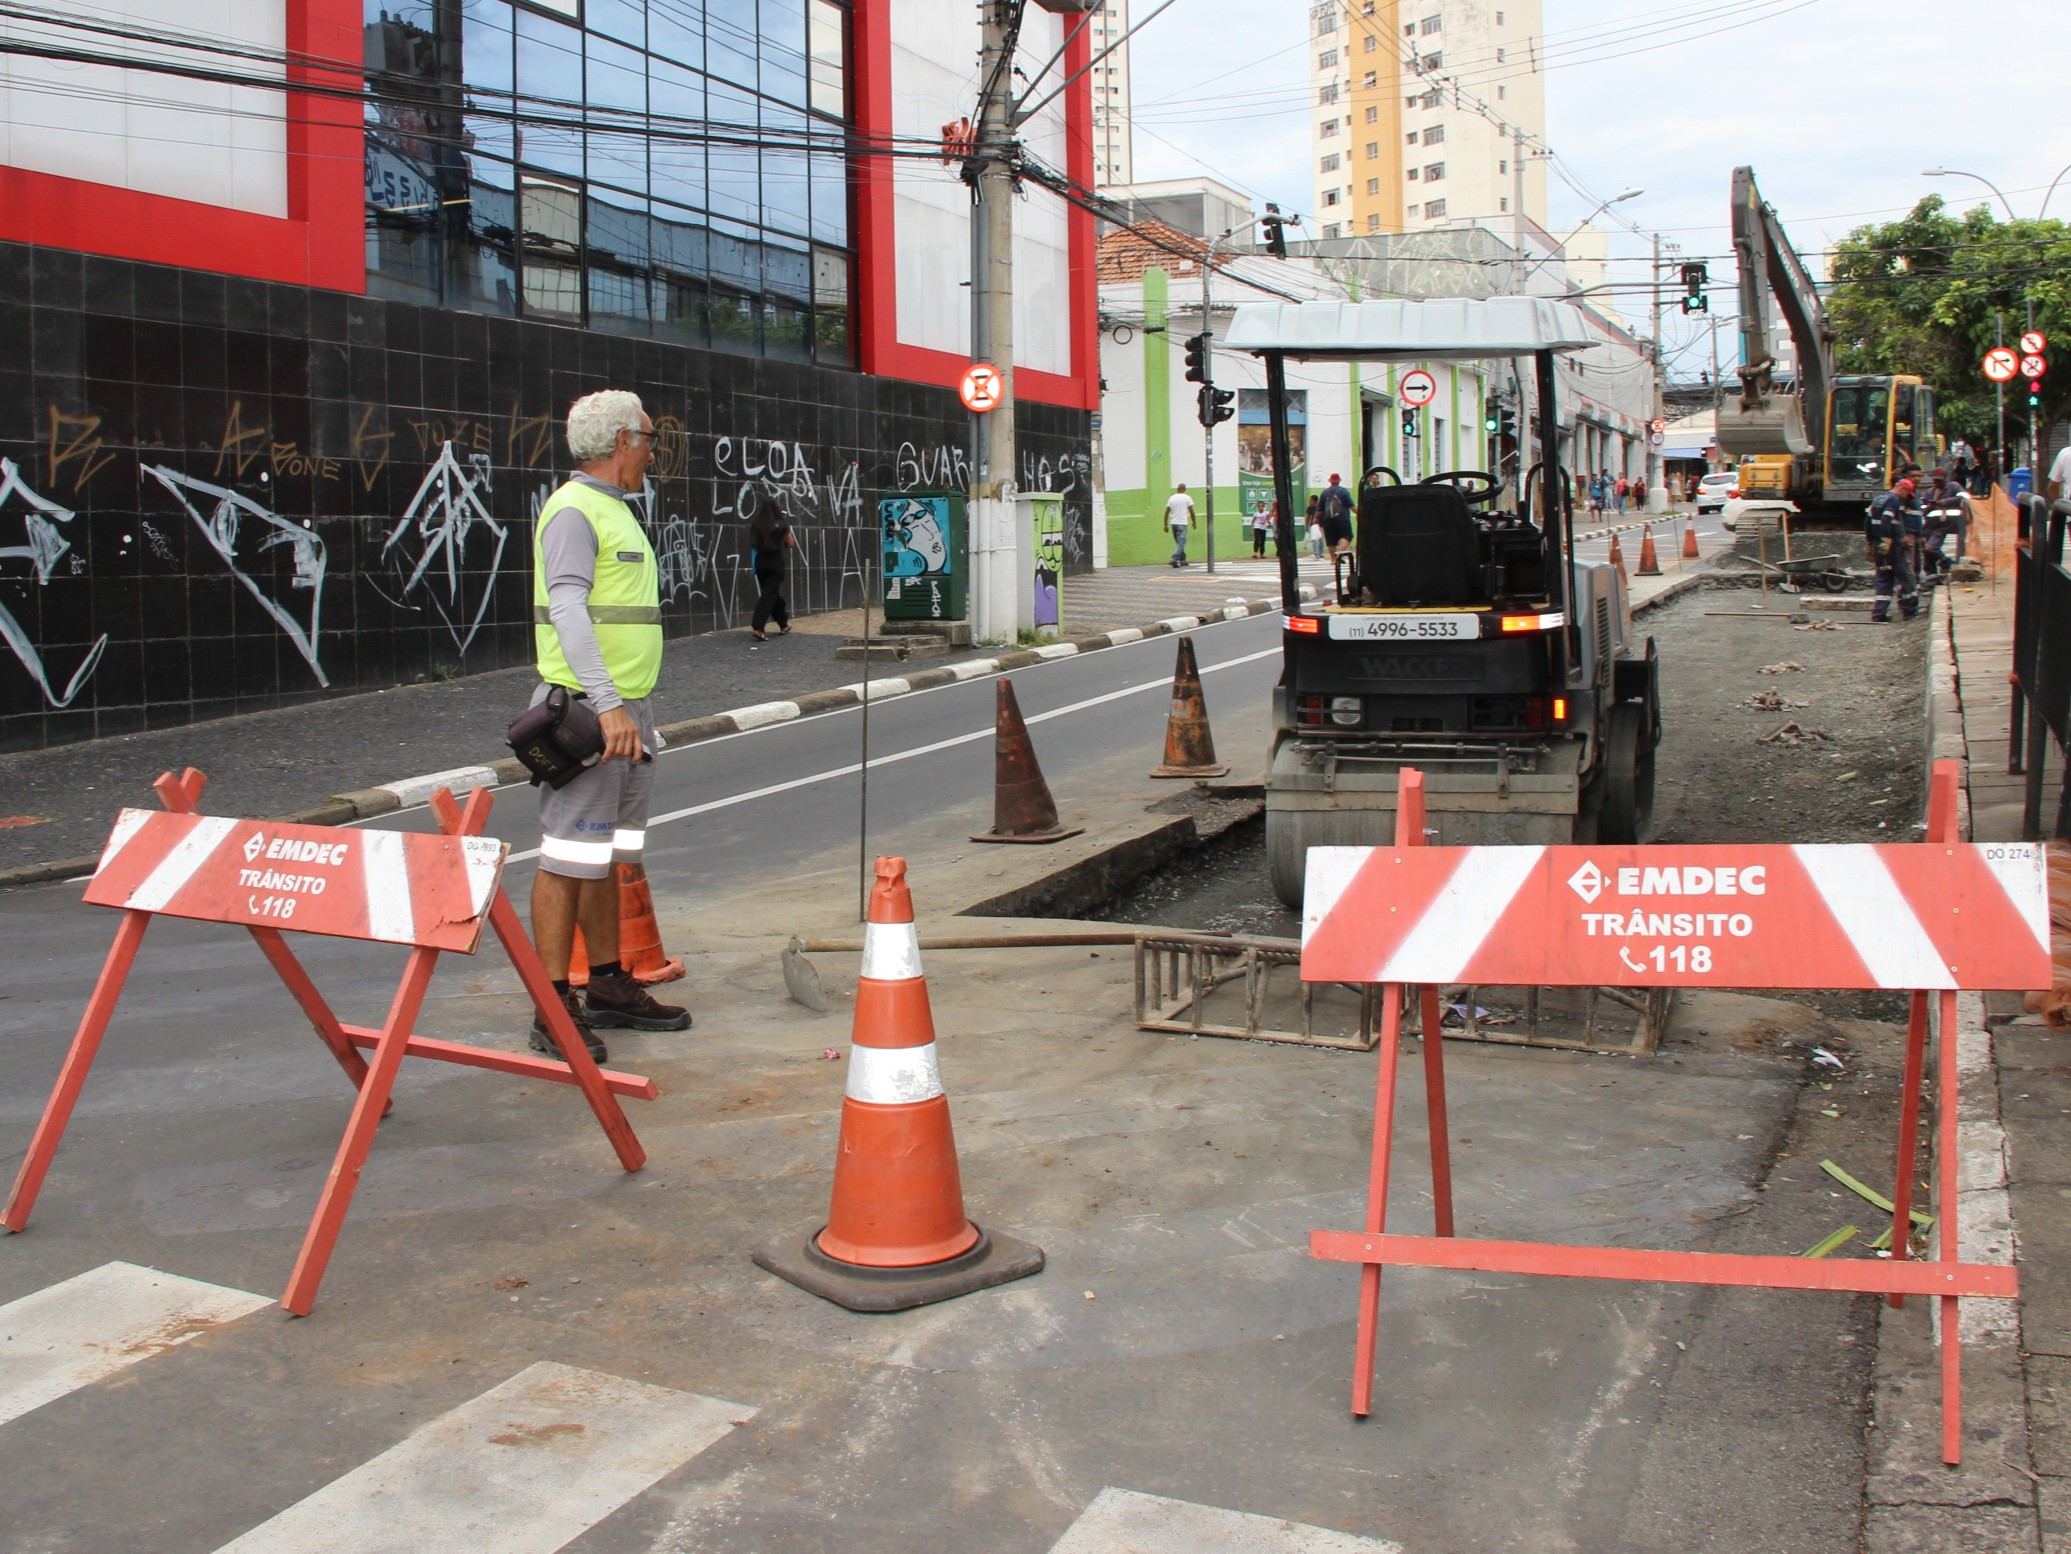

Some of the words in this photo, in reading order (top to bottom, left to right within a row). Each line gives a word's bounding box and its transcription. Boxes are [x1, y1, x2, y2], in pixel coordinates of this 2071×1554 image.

[1349, 627, 1364, 638] (11)
[1367, 622, 1458, 637] 4996-5533
[265, 838, 348, 866] EMDEC
[1987, 848, 2004, 860] DO
[2008, 848, 2030, 859] 274
[238, 868, 327, 895] TRÂNSITO
[1617, 866, 1766, 895] EMDEC
[261, 895, 297, 919] 118
[1581, 908, 1753, 937] TRÂNSITO
[1649, 945, 1712, 973] 118
